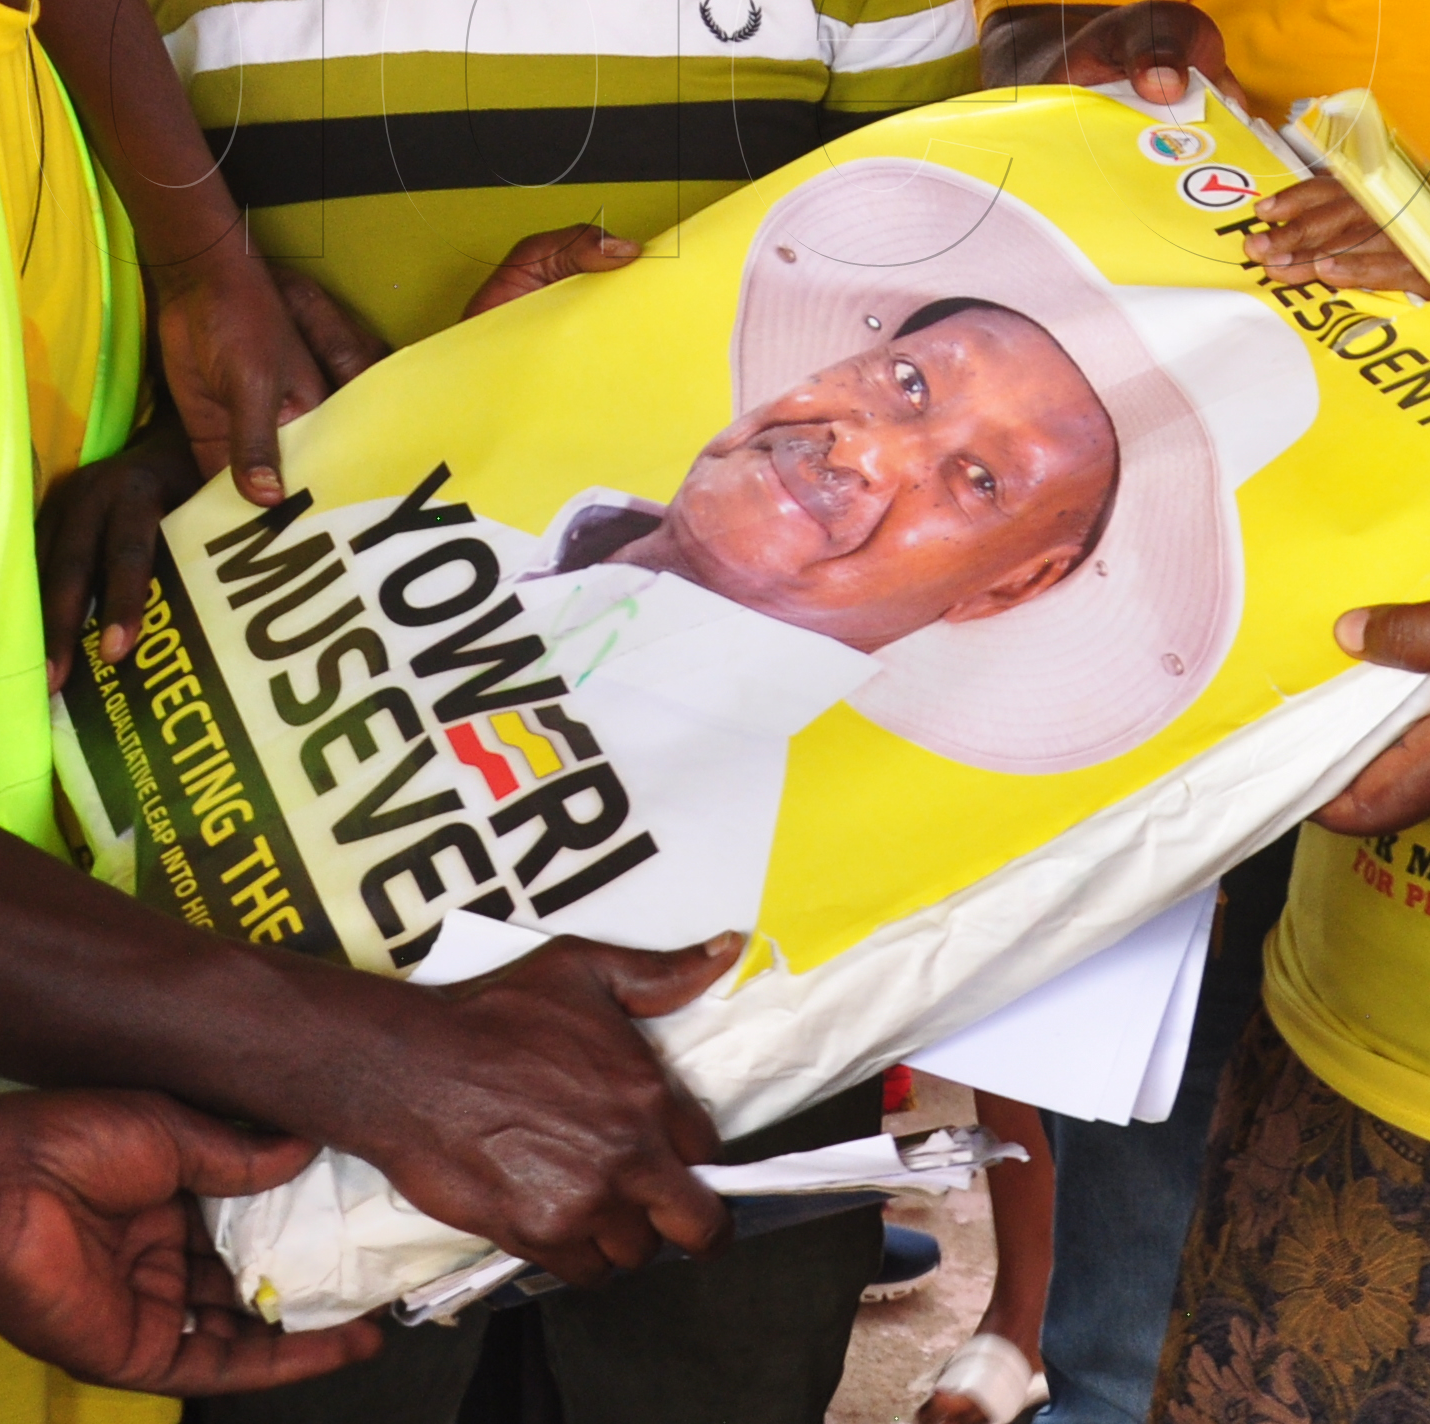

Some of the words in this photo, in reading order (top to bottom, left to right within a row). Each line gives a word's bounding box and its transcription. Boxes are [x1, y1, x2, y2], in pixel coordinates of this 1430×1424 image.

[99, 679, 120, 698] A
[349, 460, 660, 920] YOWERI
[104, 692, 158, 806] QUALITATIVE
[141, 794, 176, 846] LEAP
[160, 844, 197, 899] INTO
[220, 834, 304, 944] THE
[1352, 846, 1395, 900] FOR
